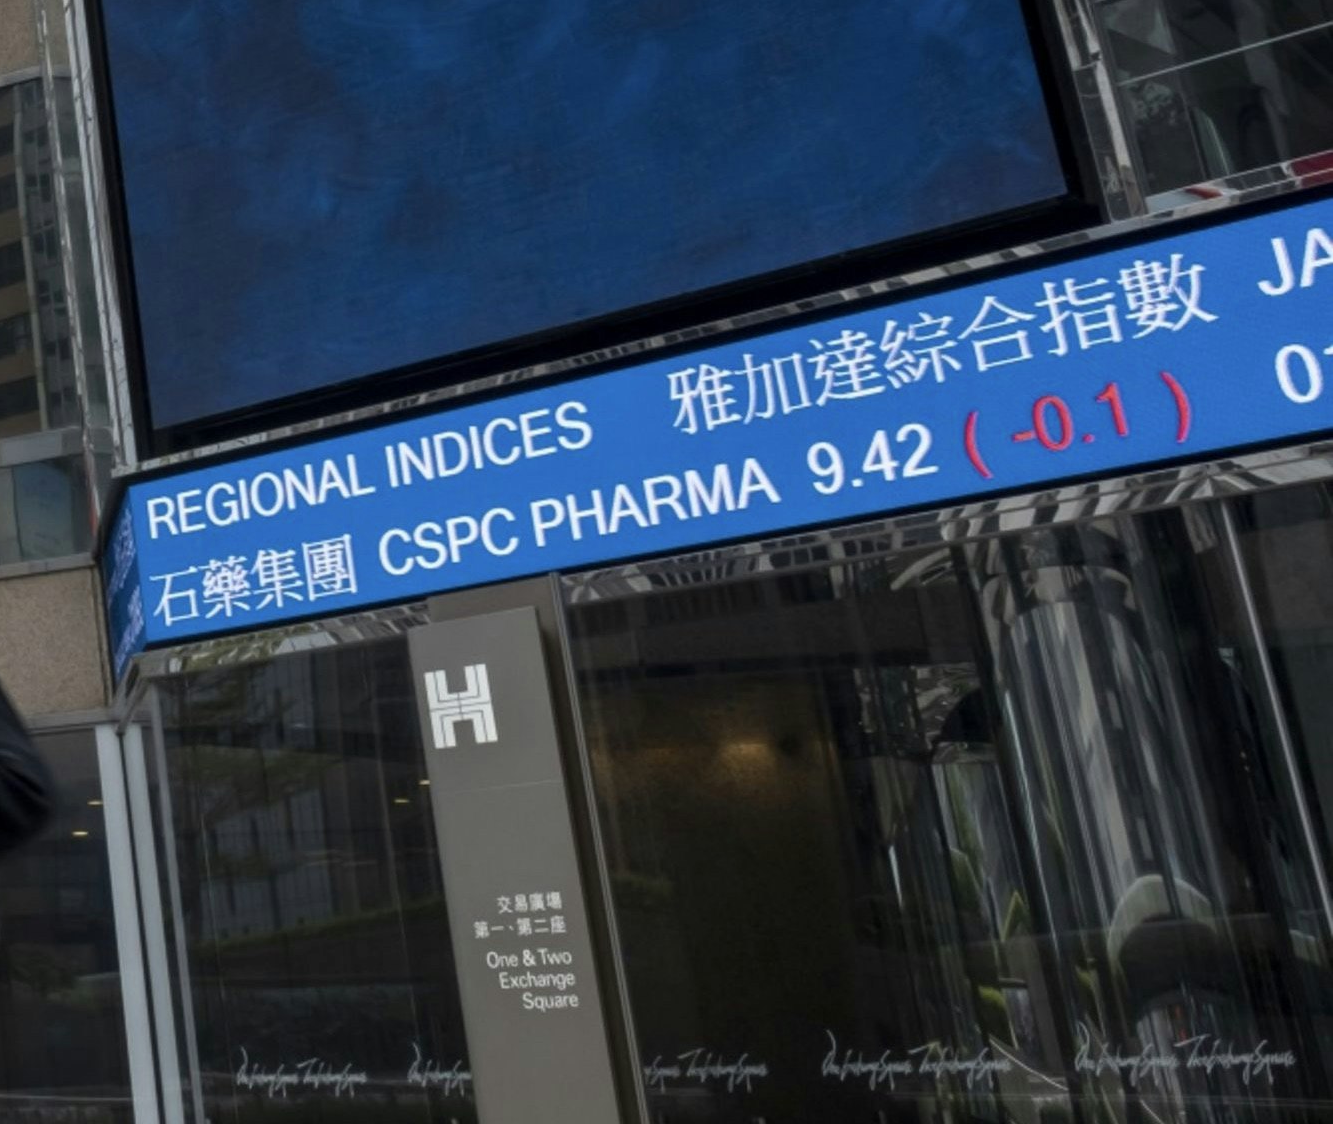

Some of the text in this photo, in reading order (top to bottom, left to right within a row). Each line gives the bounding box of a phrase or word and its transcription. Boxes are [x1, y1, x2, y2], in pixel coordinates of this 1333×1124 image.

[667, 252, 1219, 435] 雅加達綜合指數
[146, 401, 593, 539] REGIONAL INDICES
[378, 507, 519, 576] CSPC
[530, 457, 781, 547] PHARMA
[807, 422, 939, 495] 9.42
[1274, 343, 1333, 404] 0
[149, 534, 358, 627] 石藥集團
[486, 947, 573, 969] One & Two
[498, 971, 576, 990] Exchange
[522, 991, 579, 1013] Square
